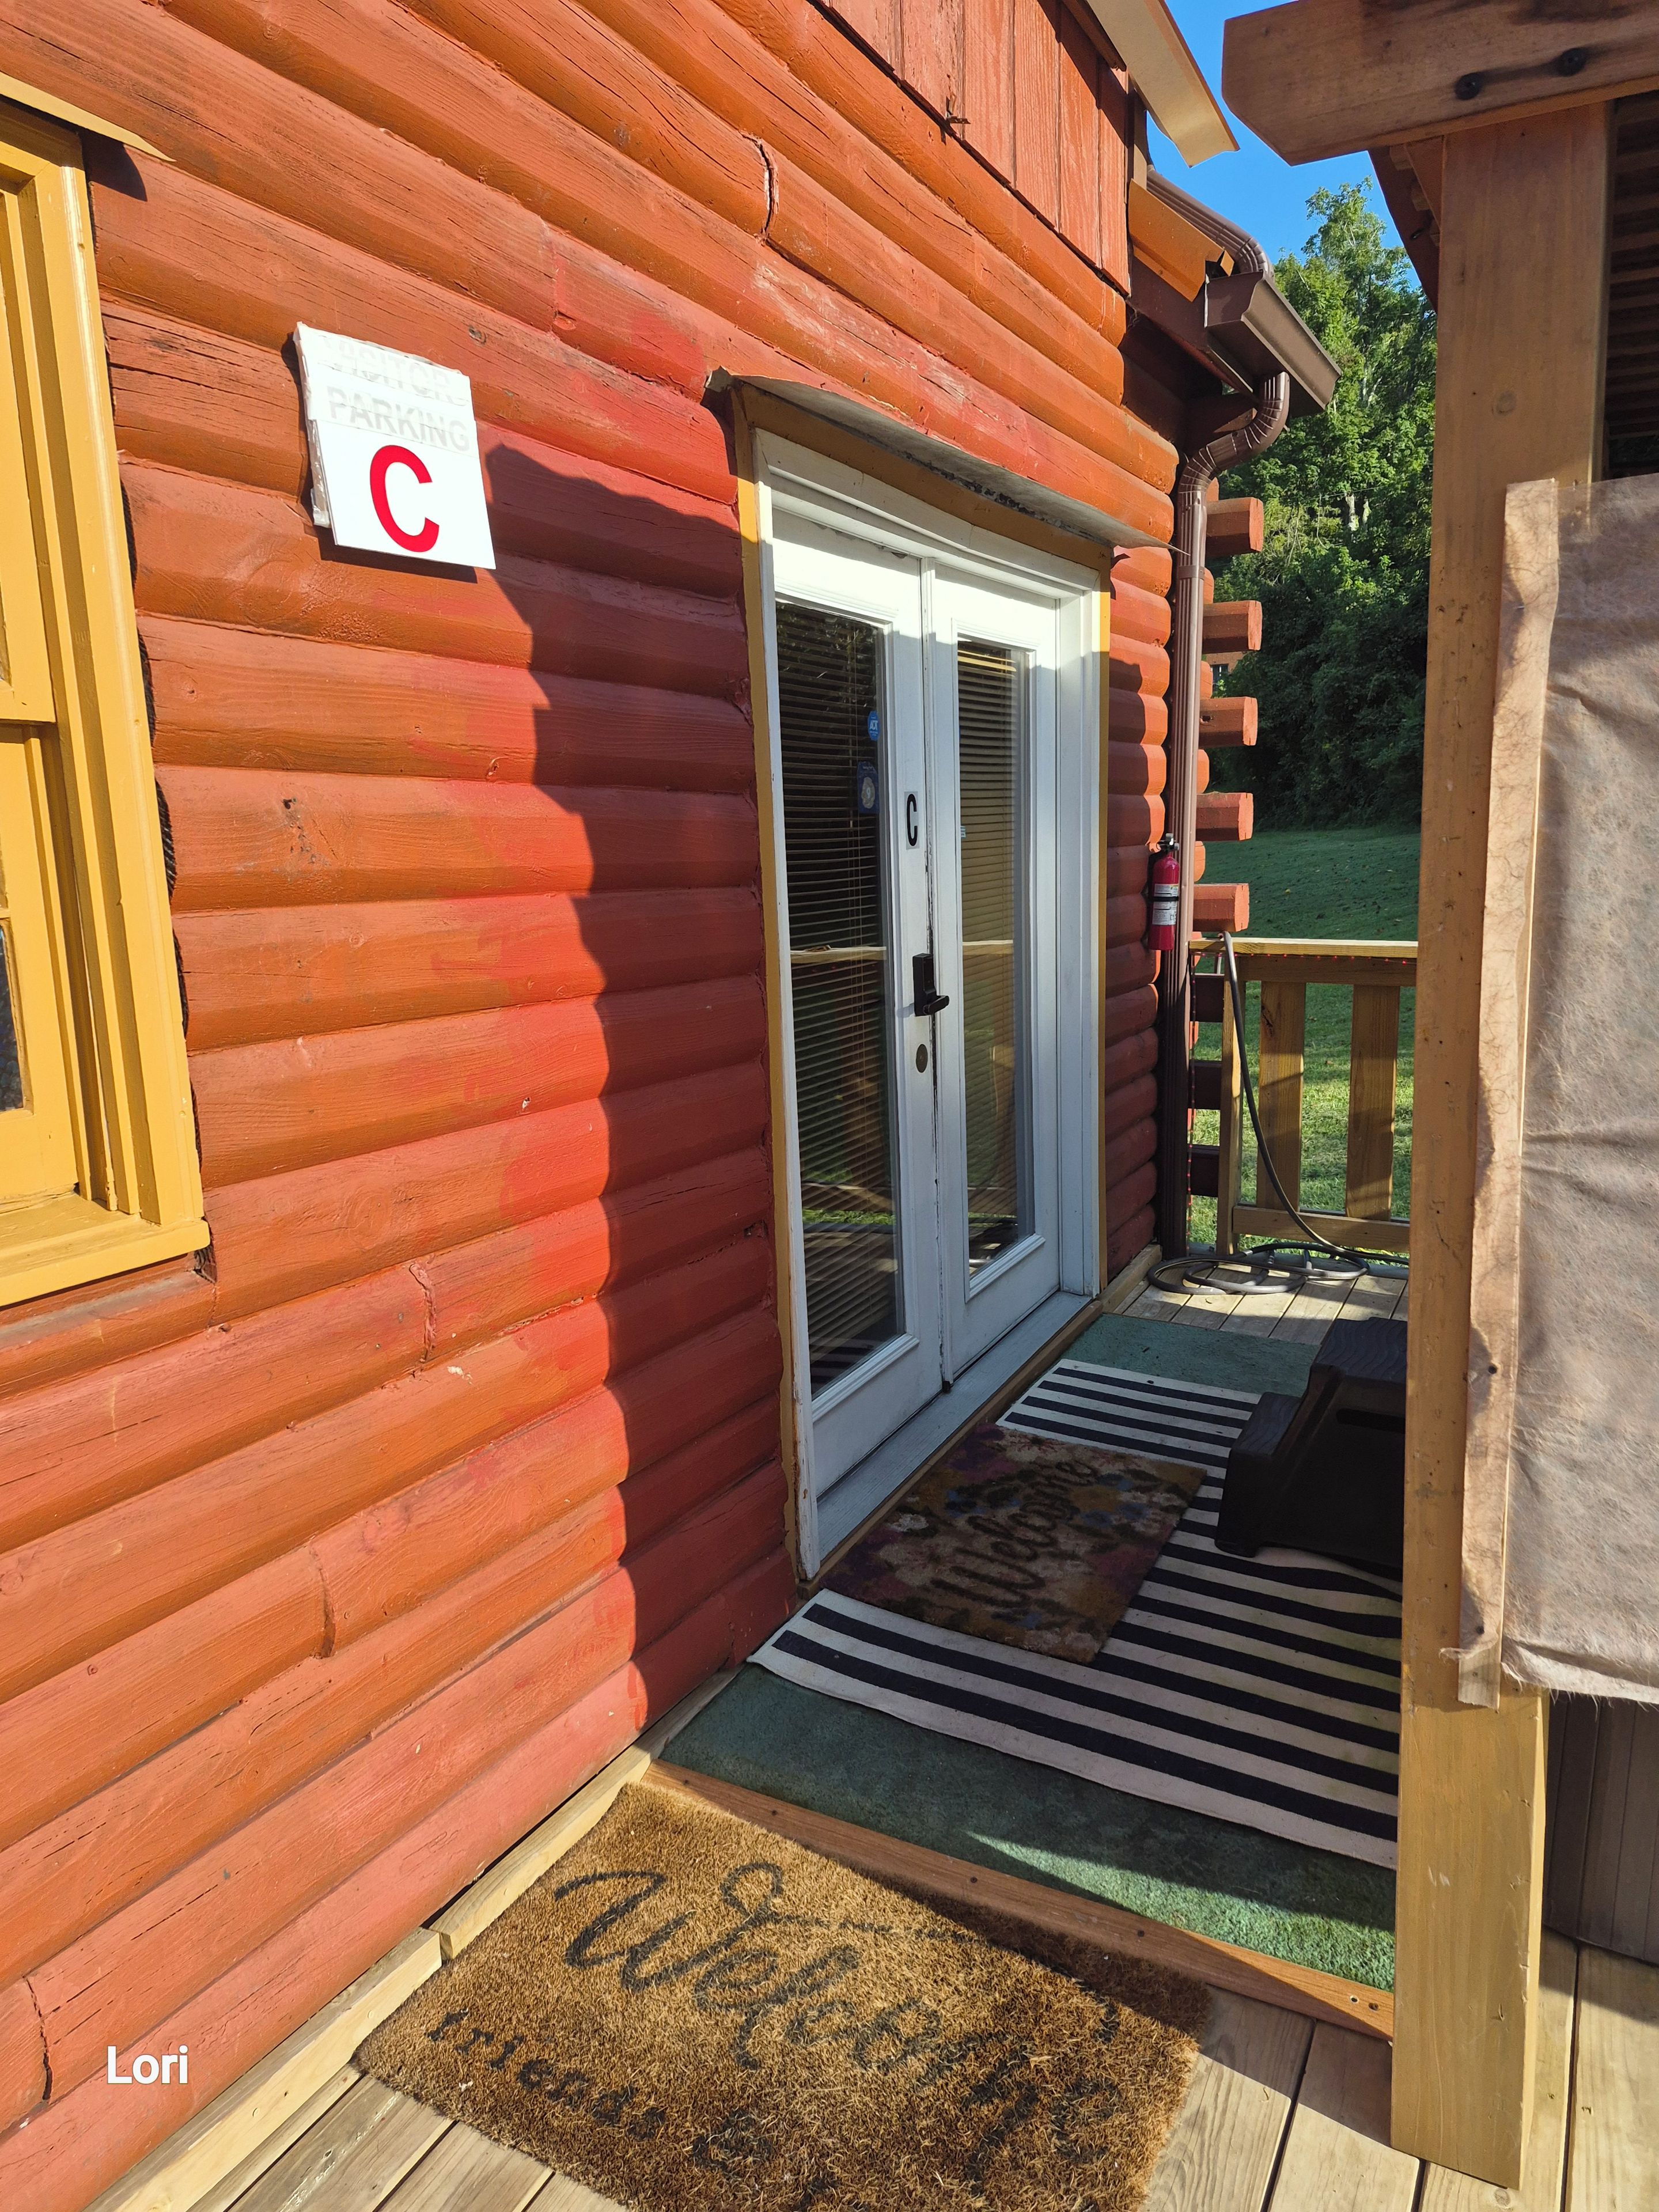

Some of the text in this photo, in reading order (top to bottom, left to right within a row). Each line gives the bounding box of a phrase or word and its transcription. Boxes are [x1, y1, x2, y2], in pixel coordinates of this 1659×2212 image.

[327, 385, 470, 452] PARKING
[370, 445, 440, 552] C
[869, 719, 878, 731] ADT
[906, 793, 917, 846] C
[929, 1459, 1099, 1608] Welcome
